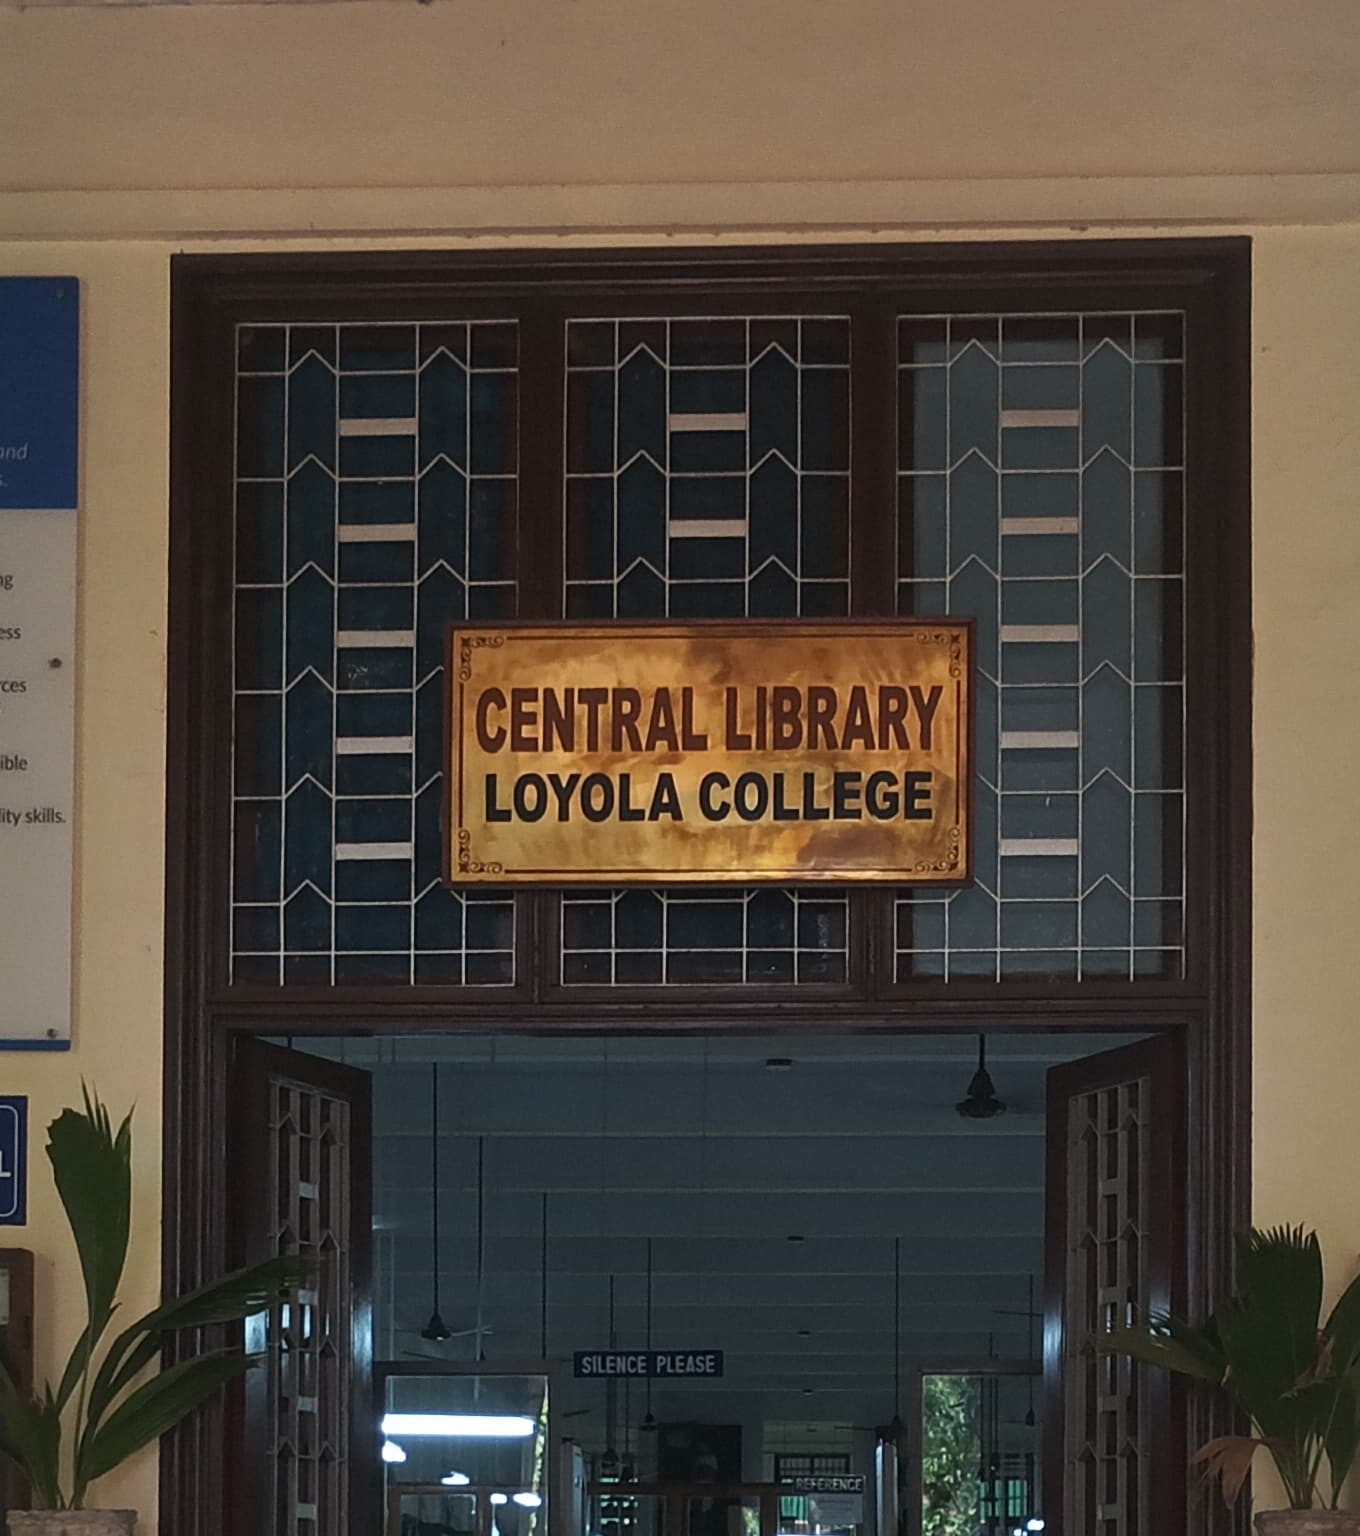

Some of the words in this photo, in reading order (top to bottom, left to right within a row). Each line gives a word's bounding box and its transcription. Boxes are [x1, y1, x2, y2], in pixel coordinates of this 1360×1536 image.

[475, 686, 709, 754] CENTRAL
[726, 684, 943, 751] LIBRARY
[485, 772, 683, 823] LOYOLA
[698, 770, 934, 822] COLLEGE
[25, 808, 66, 824] skills.
[582, 1355, 647, 1374] SILENCE
[656, 1355, 715, 1373] PLEASE
[796, 1478, 862, 1491] REFERENCE
